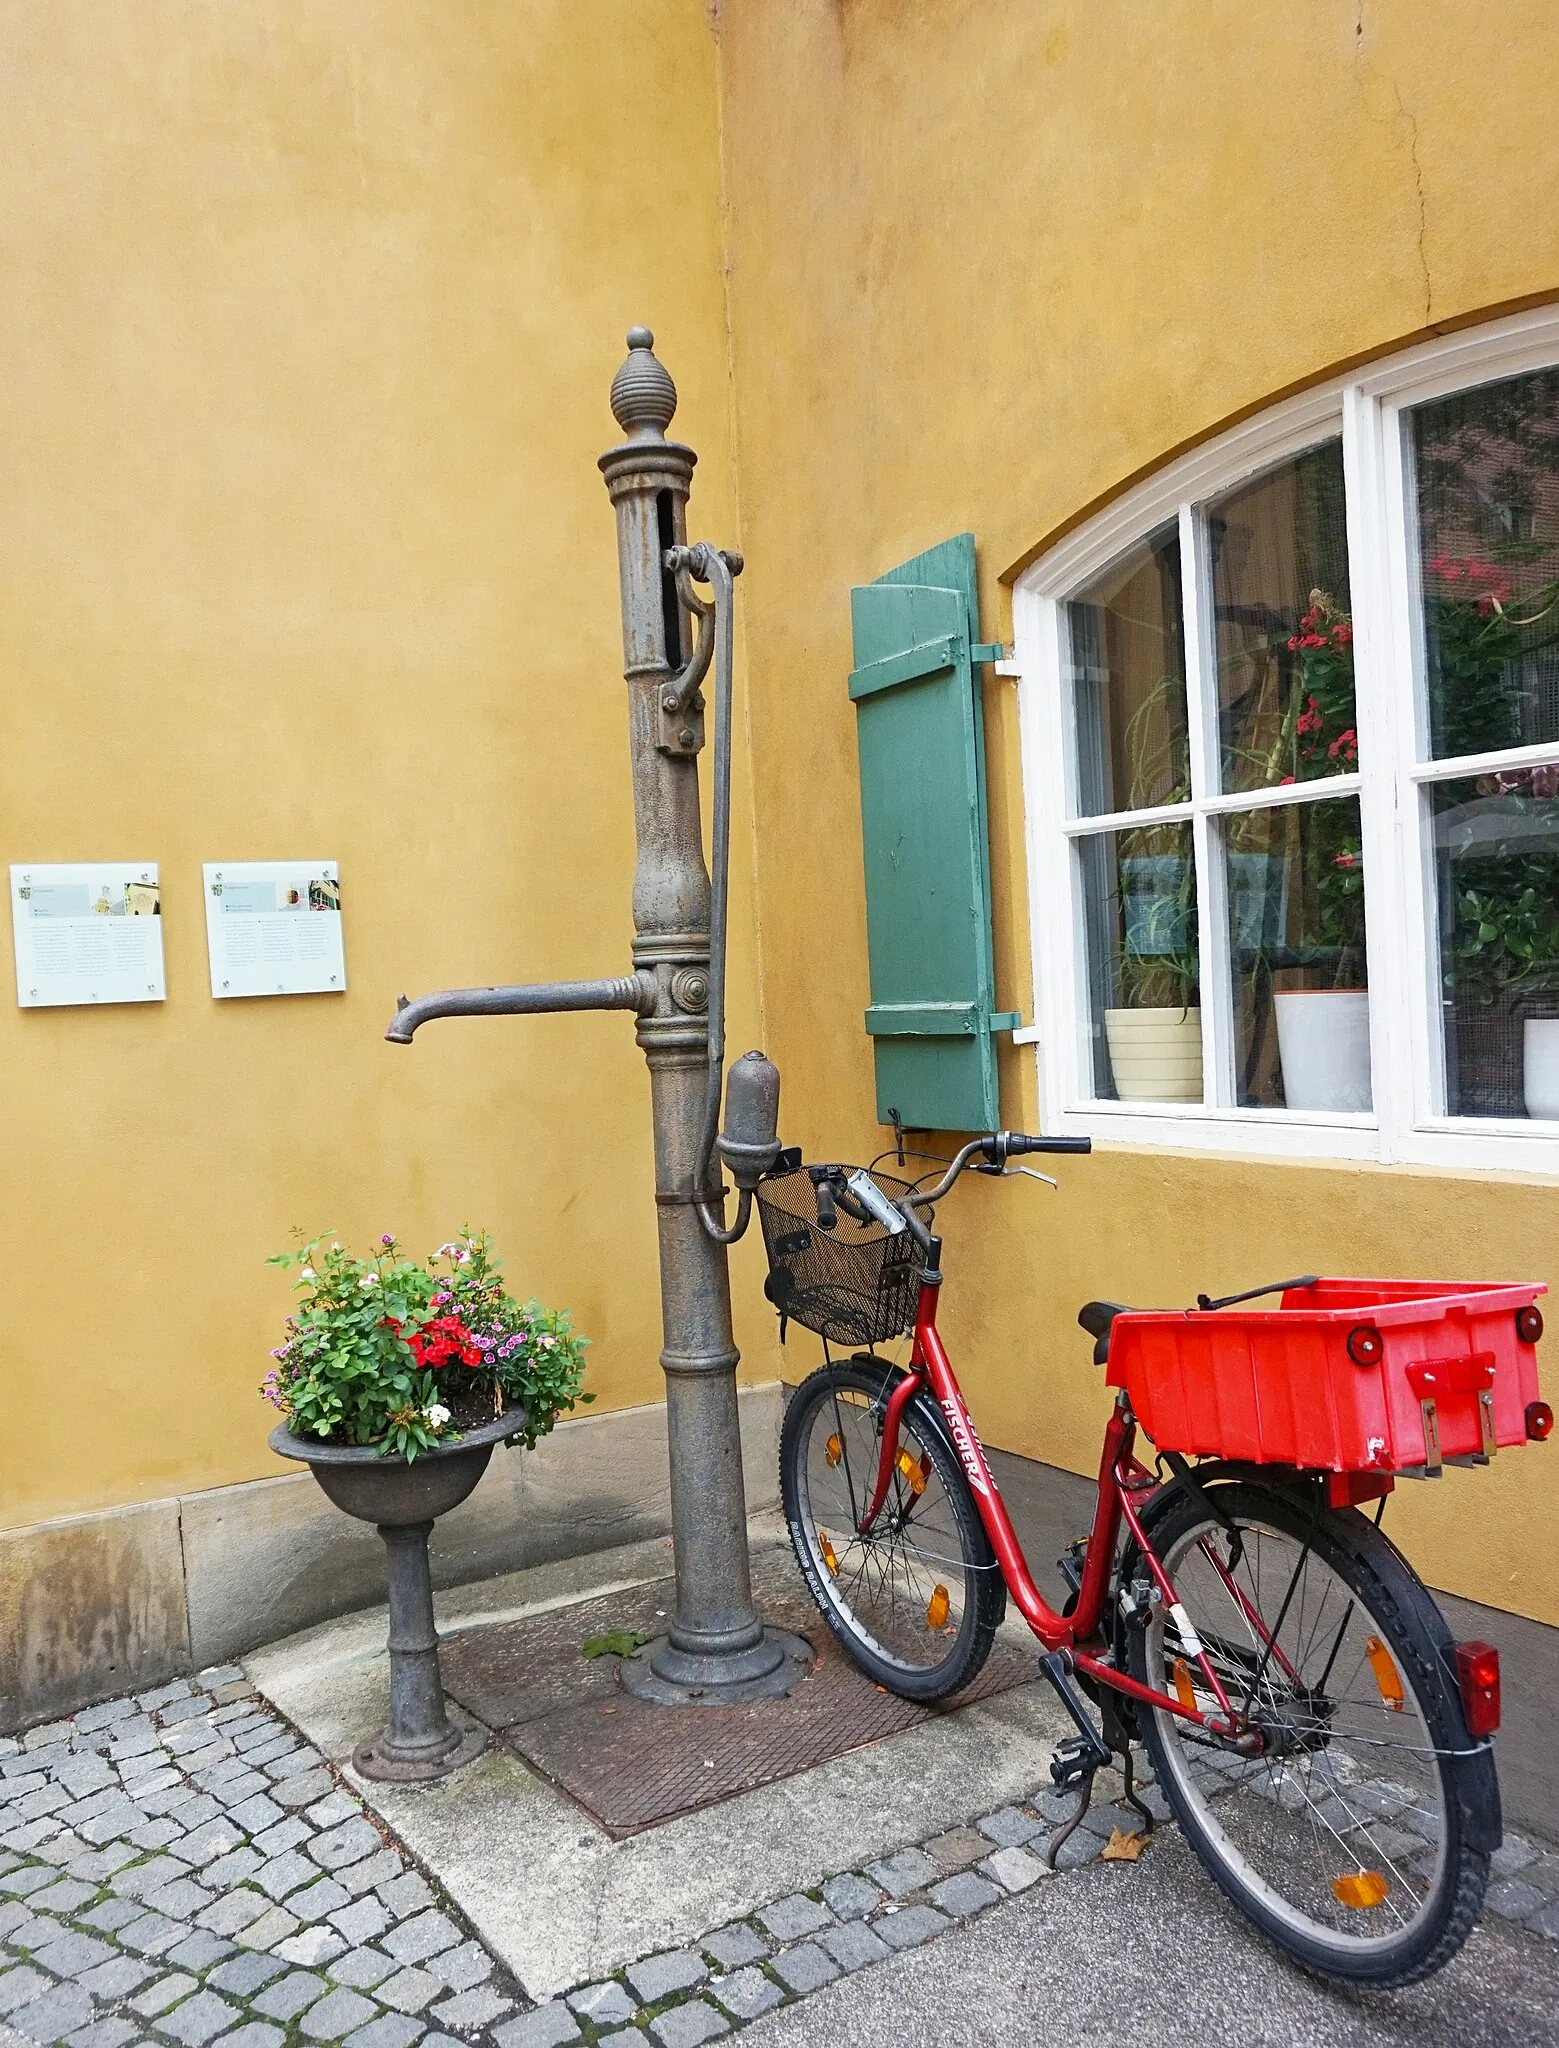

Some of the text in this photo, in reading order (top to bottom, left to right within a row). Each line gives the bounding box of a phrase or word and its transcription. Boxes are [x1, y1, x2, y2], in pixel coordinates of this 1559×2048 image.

[941, 1399, 978, 1475] FISCHER
[790, 1521, 828, 1610] RACING RALPH
